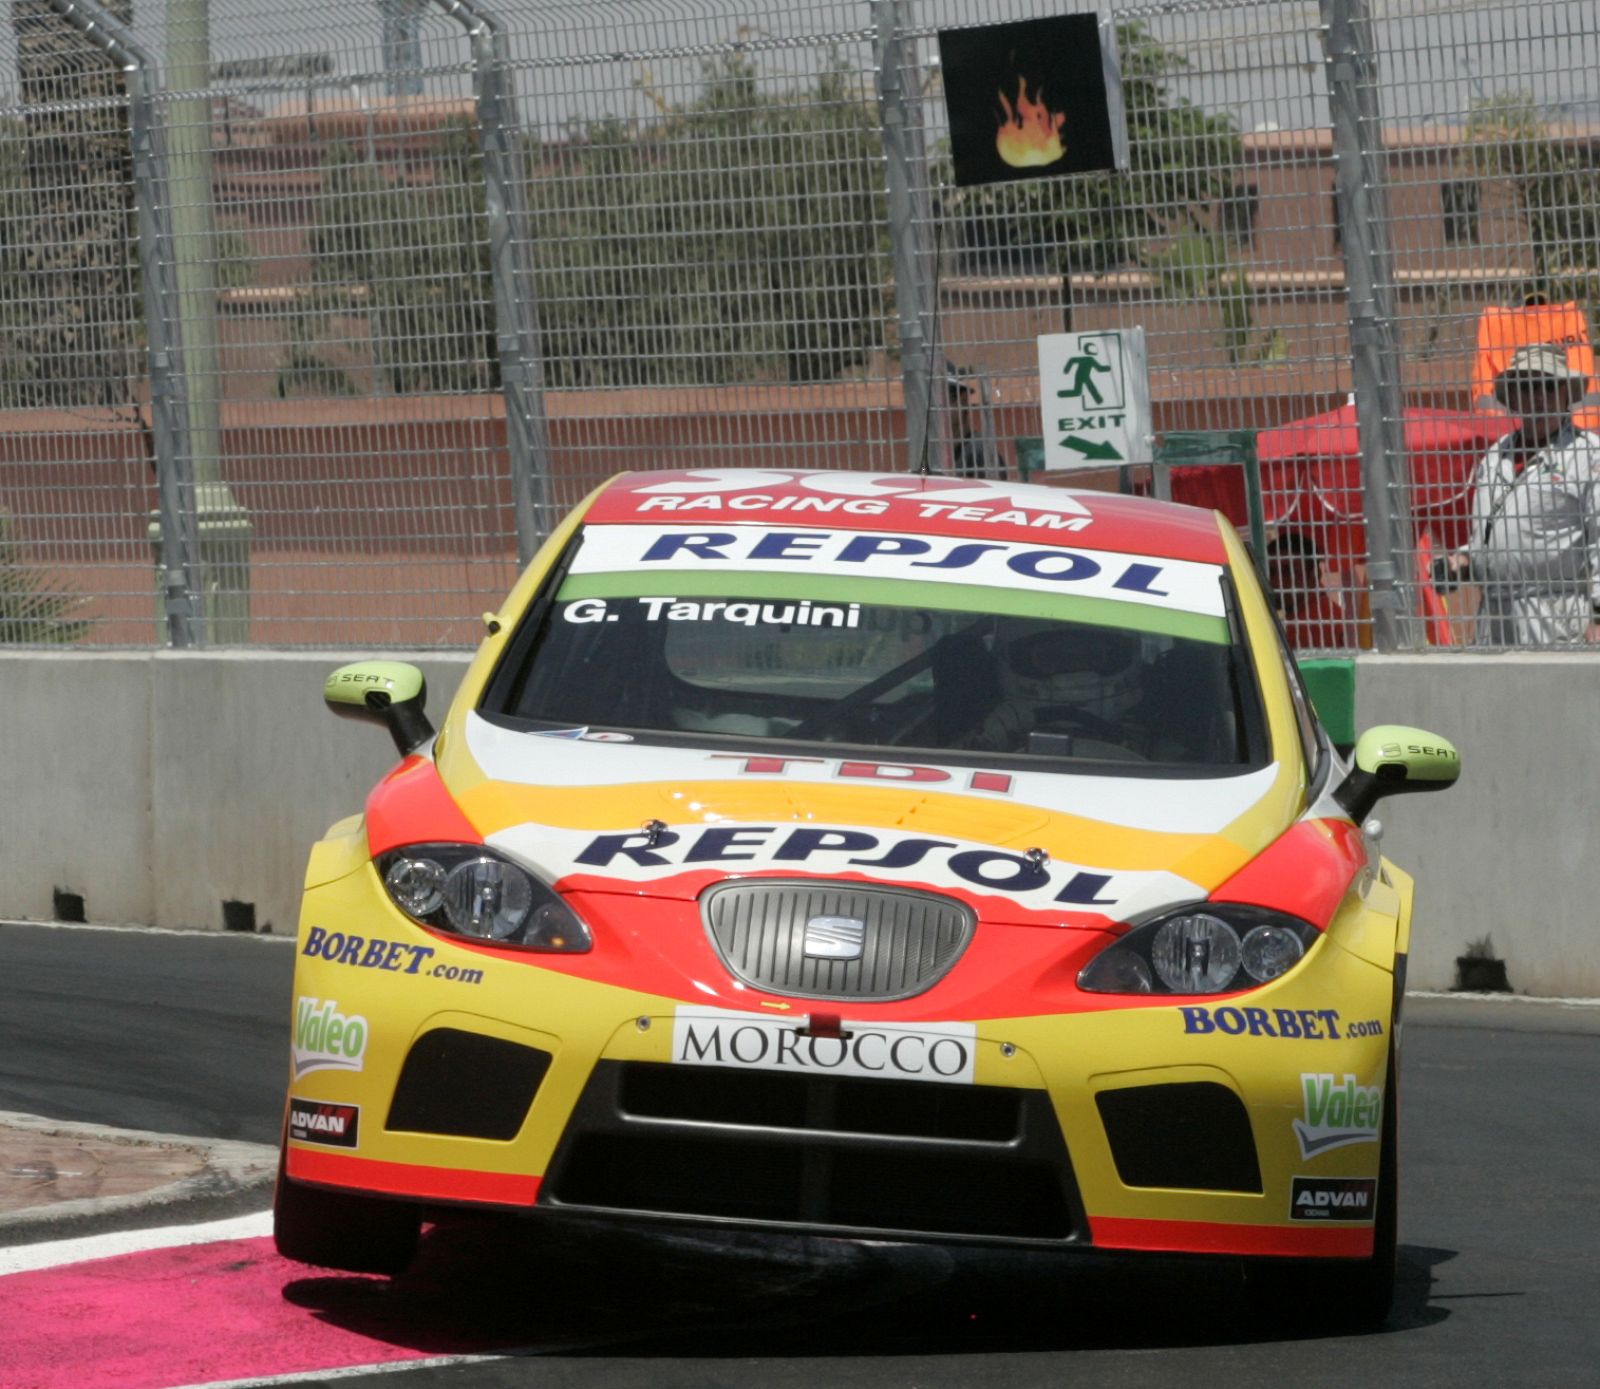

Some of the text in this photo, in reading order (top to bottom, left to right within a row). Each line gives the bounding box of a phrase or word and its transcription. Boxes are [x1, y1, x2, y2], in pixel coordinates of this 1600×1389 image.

[1058, 414, 1126, 431] EXIT
[636, 495, 1093, 532] RACING TEAM
[640, 532, 1169, 597] REPSOL
[563, 598, 619, 624] G.
[638, 597, 861, 628] Tarquini
[341, 673, 395, 686] SEAT
[1407, 744, 1457, 761] SEAT
[710, 754, 1013, 793] TDI
[573, 826, 1119, 905] REPSOL
[302, 926, 485, 984] BORBET.com
[298, 999, 365, 1058] Valeo
[1178, 1006, 1384, 1040] BORBET.com
[679, 1024, 968, 1077] MOROCCO
[291, 1110, 345, 1133] ADVAN
[1304, 1077, 1380, 1129] Valeo
[1296, 1190, 1368, 1207] ADVAN
